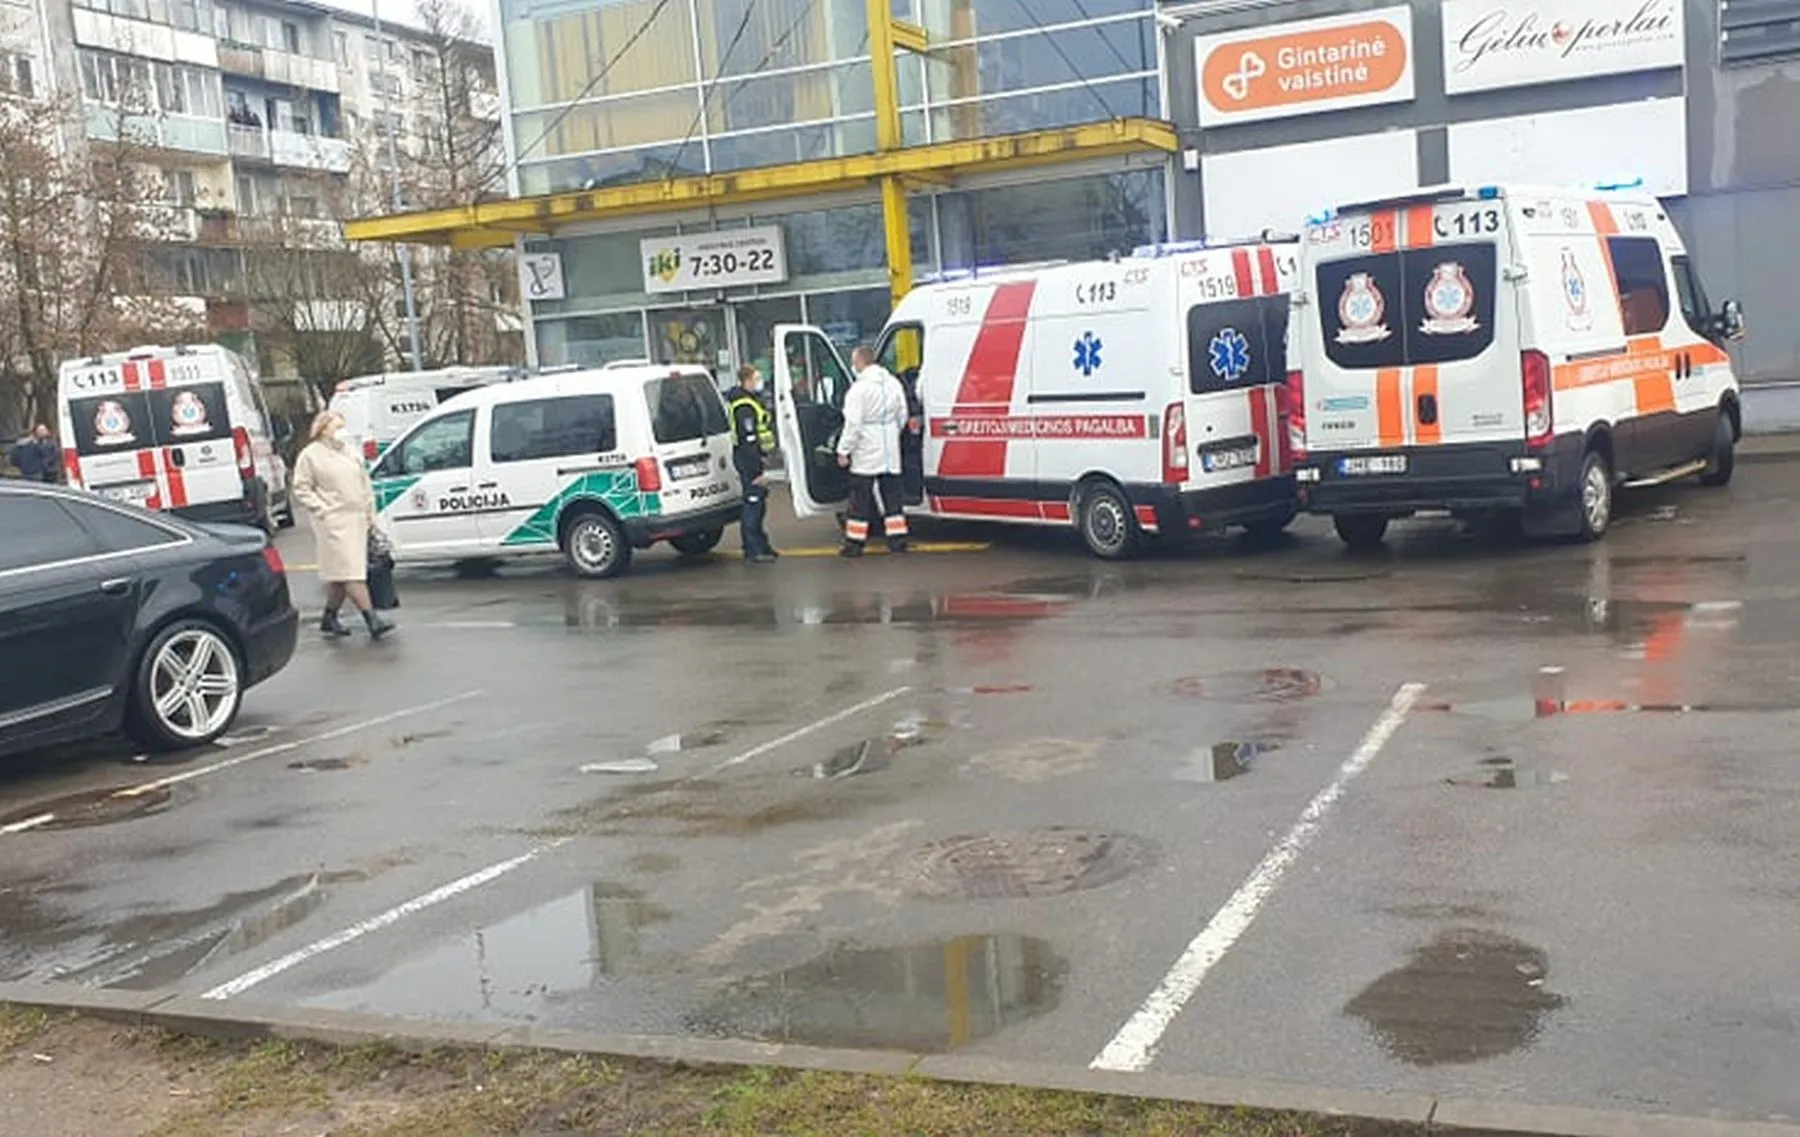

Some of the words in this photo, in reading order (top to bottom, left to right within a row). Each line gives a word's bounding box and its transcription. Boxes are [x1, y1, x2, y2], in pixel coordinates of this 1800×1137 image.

[1560, 0, 1675, 58] perlai
[1278, 35, 1386, 69] Gintarinė
[1278, 62, 1369, 92] vaistinė
[1350, 221, 1394, 246] 1501
[1453, 210, 1500, 235] 113
[649, 247, 681, 277] iki
[689, 249, 775, 277] 7:30-22
[1089, 281, 1116, 301] 113
[1198, 275, 1236, 298] 1519
[88, 370, 119, 387] 113
[440, 492, 510, 510] POLICIJA
